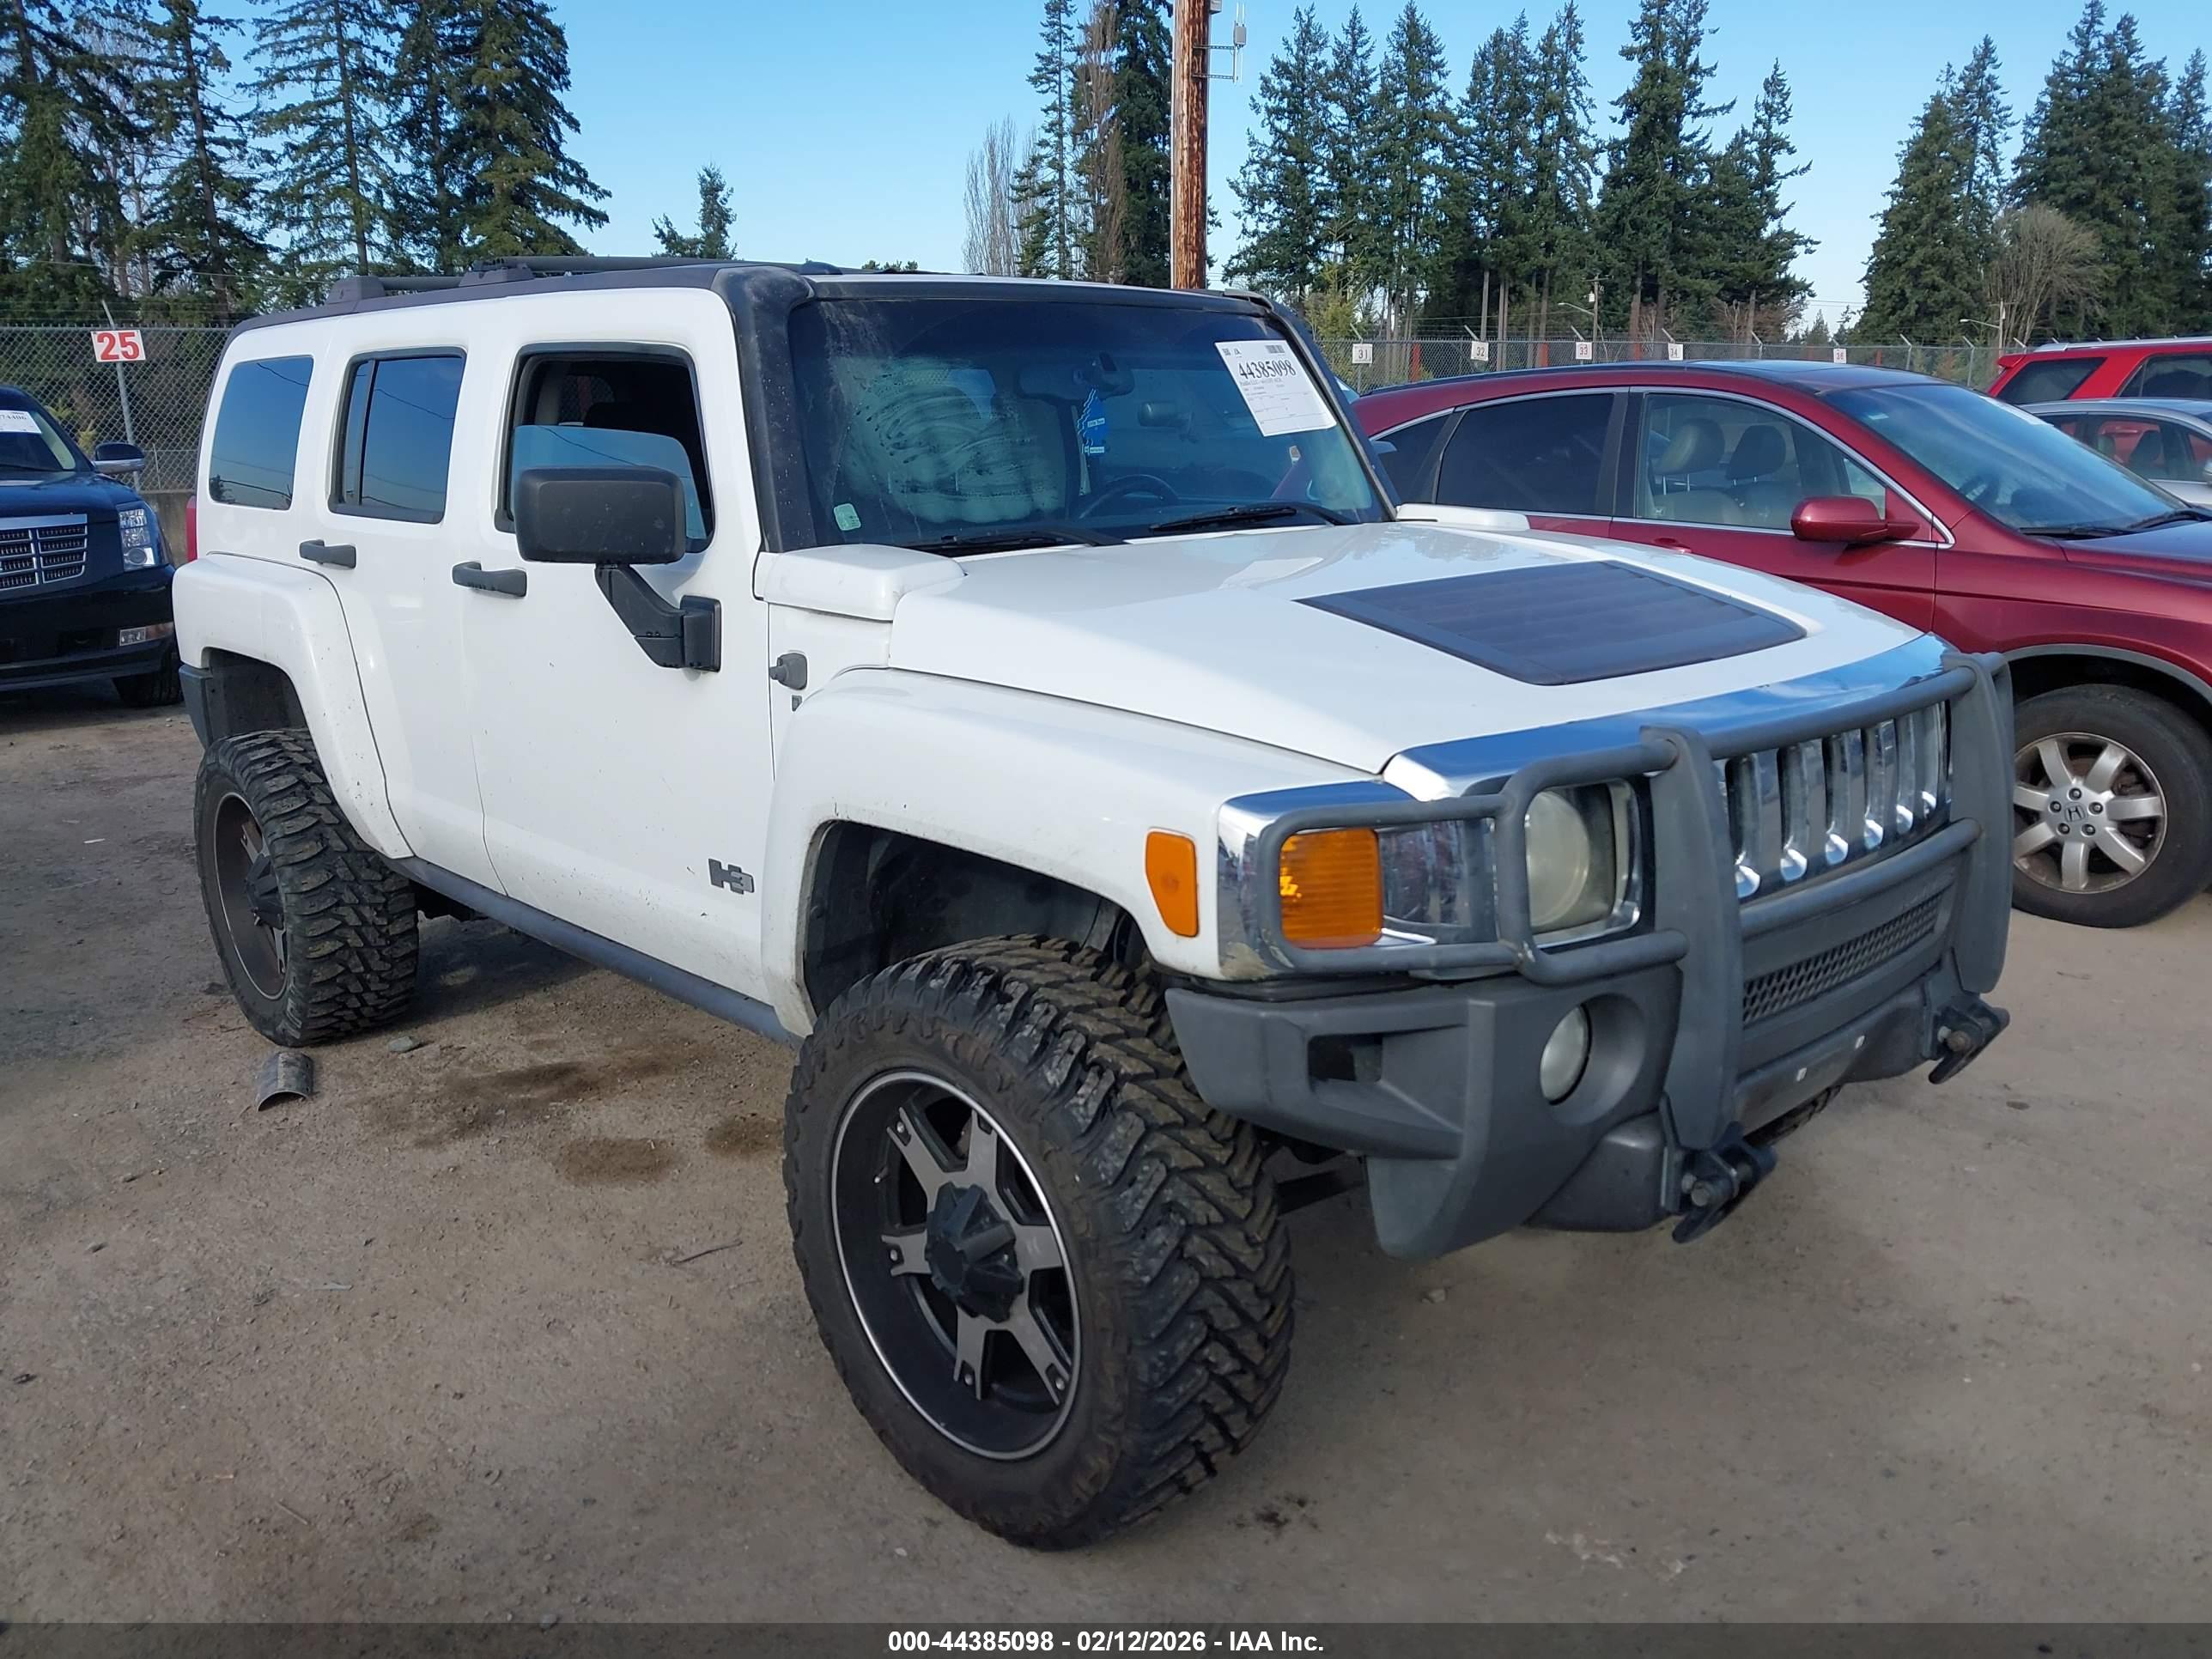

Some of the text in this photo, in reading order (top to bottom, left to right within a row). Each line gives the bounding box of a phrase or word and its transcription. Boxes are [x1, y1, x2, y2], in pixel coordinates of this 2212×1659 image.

[97, 332, 139, 360] 25
[1358, 349, 1368, 360] 31
[1476, 346, 1486, 357] 32
[1238, 359, 1297, 380] 44385098
[708, 858, 755, 895] H3
